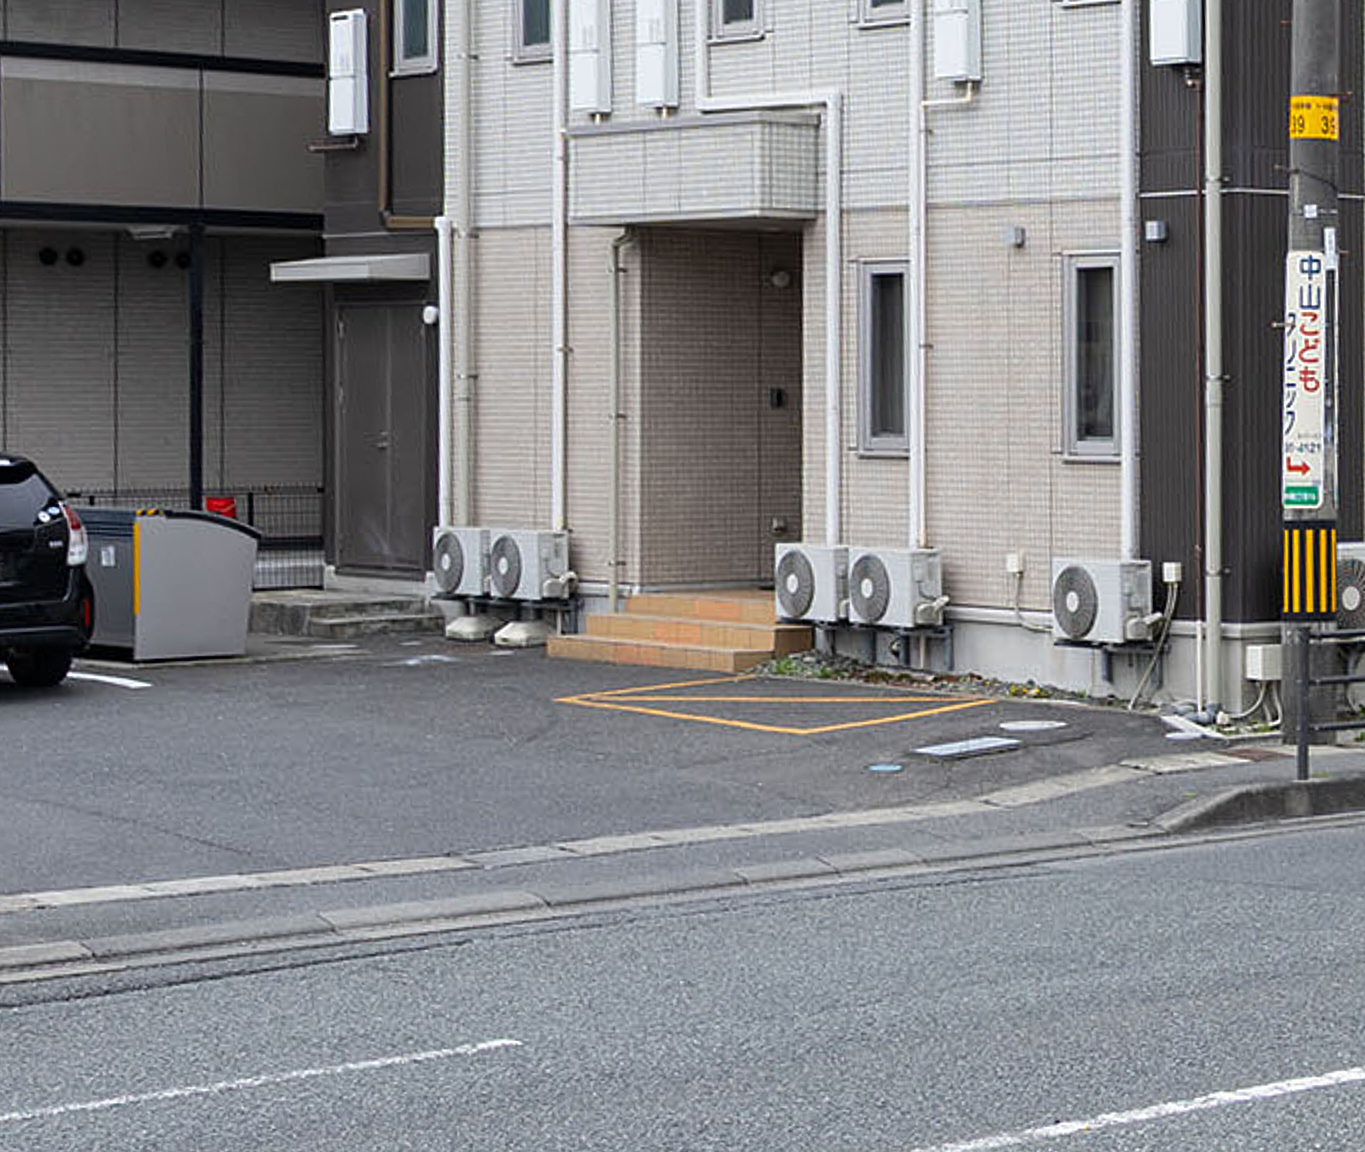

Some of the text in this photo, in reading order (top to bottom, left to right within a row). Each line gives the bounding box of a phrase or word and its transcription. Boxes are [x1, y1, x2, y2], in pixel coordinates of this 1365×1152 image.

[1298, 254, 1321, 392] 中山こども
